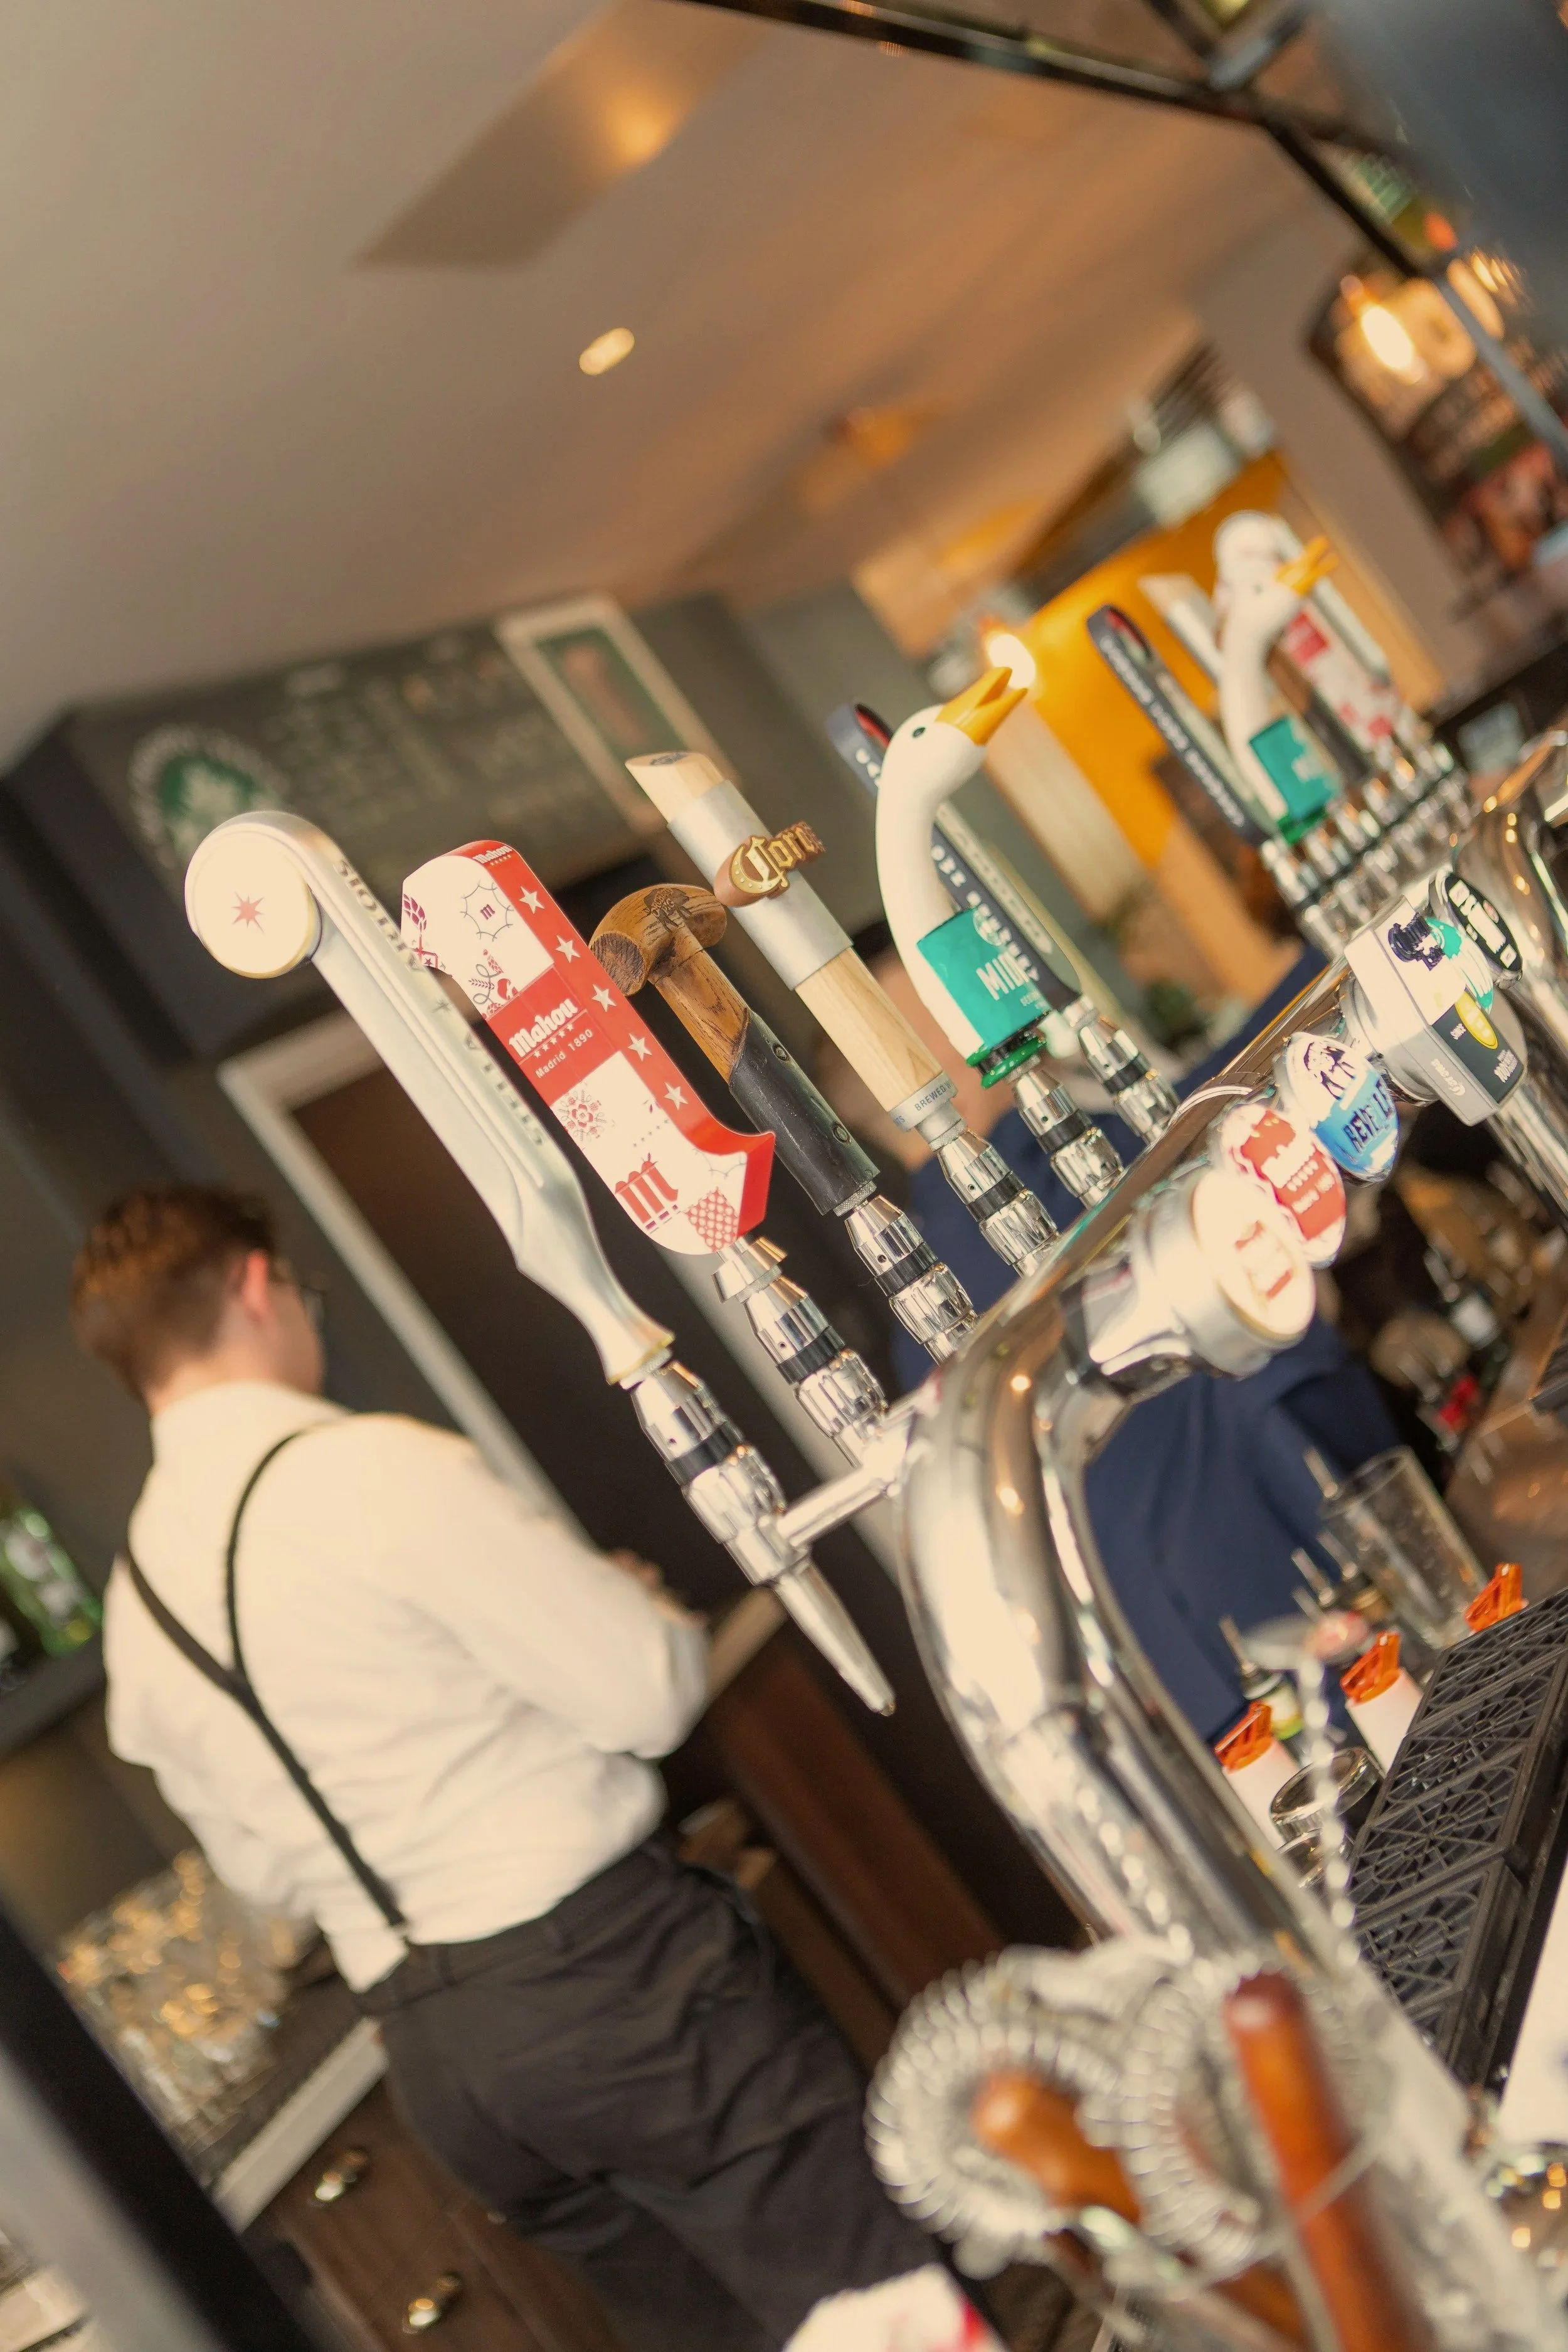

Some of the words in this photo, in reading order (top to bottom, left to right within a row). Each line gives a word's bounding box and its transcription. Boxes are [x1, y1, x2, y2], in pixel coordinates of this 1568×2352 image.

[472, 845, 512, 864] Mahou
[334, 859, 424, 972] ARTOIS
[662, 898, 675, 914] PIG
[509, 998, 578, 1057] Mahou
[535, 1051, 566, 1079] Madrid
[568, 1029, 593, 1051] 1890
[914, 1084, 946, 1111] BREWED
